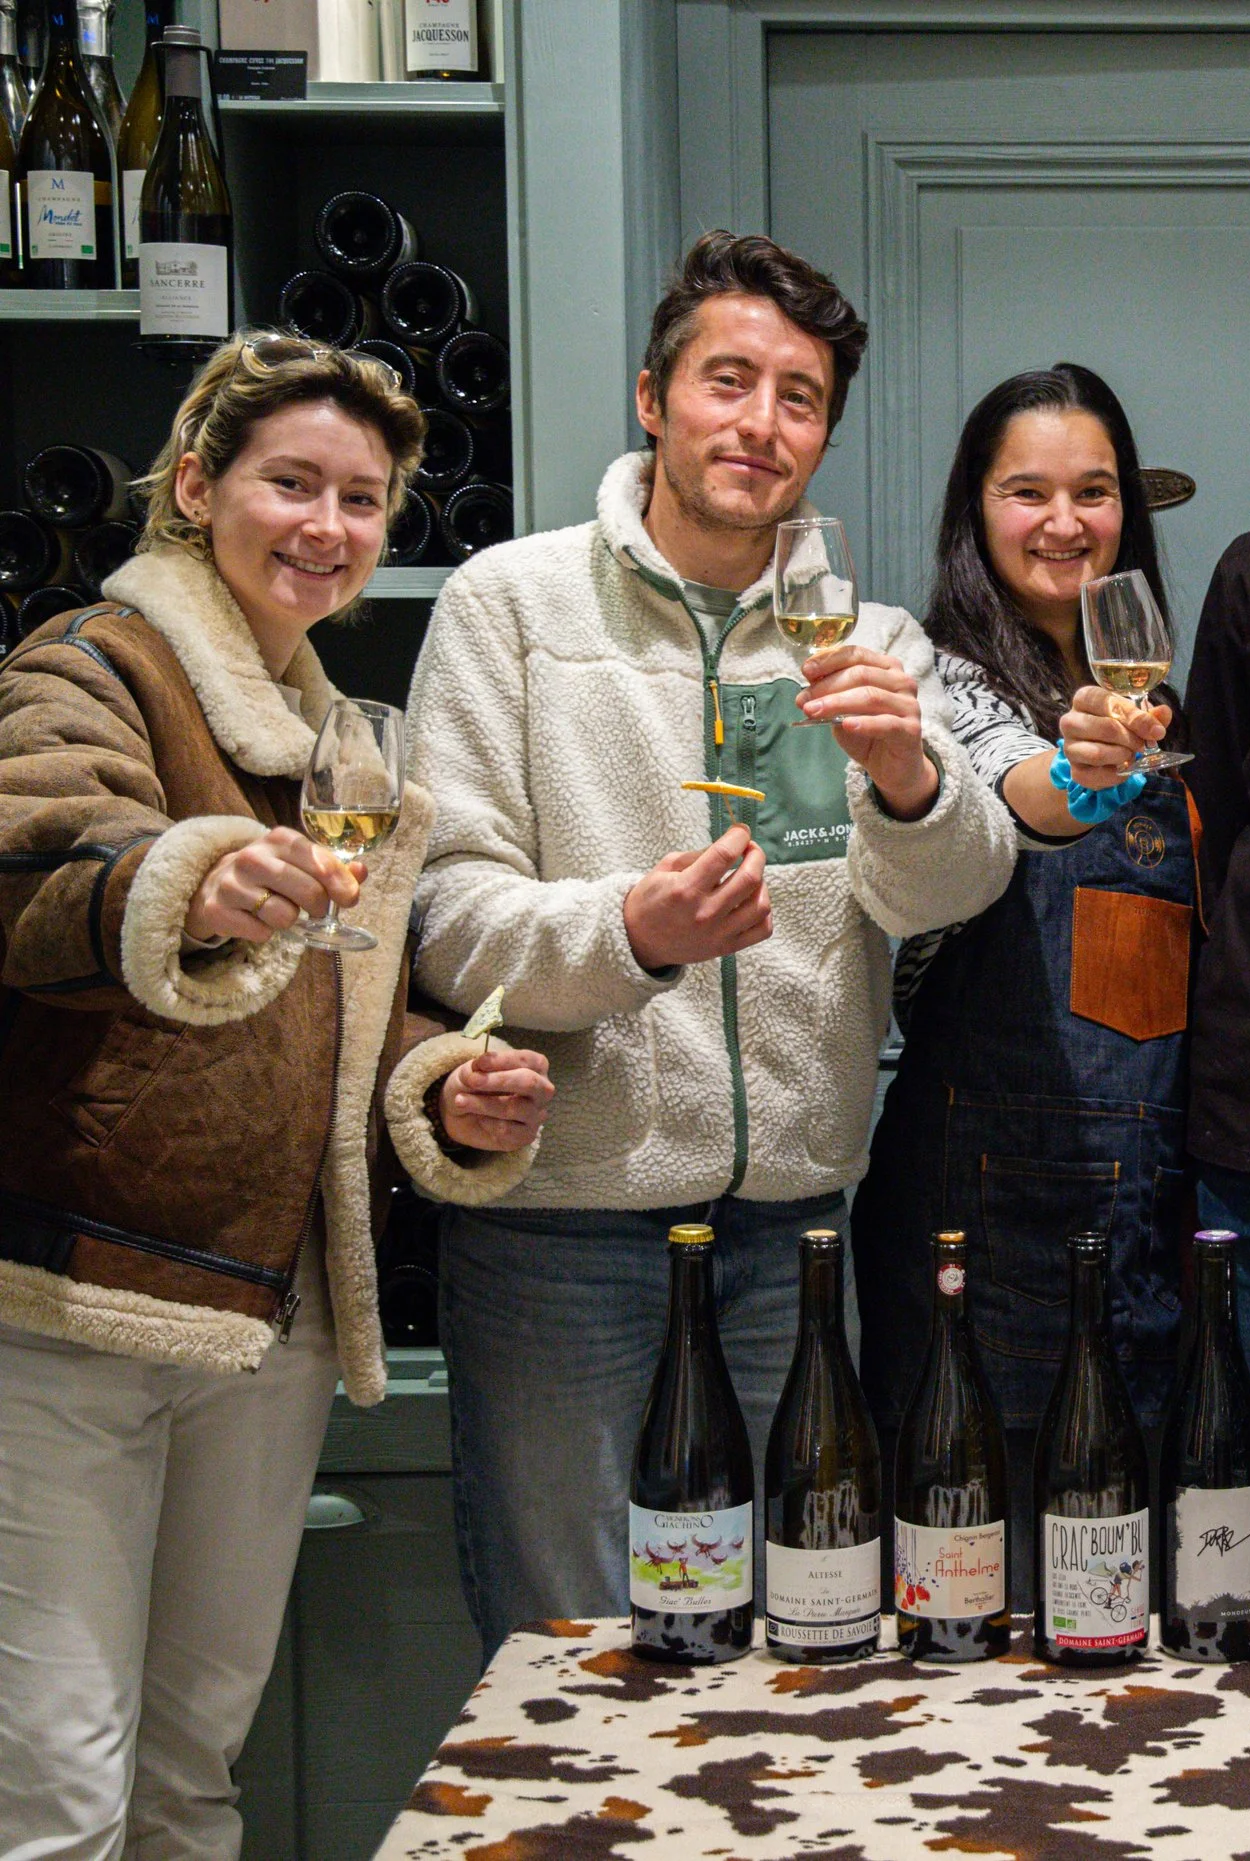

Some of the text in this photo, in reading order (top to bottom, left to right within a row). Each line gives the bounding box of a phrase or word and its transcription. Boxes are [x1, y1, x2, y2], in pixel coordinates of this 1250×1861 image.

[412, 29, 469, 42] JACQUESSON
[51, 178, 65, 190] M
[149, 279, 206, 289] SANCERRE
[938, 1547, 963, 1559] Saint
[1051, 1522, 1088, 1572] CRAC
[935, 1558, 1000, 1577] Anthelme
[807, 1570, 843, 1579] ALTESSE
[769, 1589, 878, 1606] DOMAINE SAINT-GERMAIN
[780, 1621, 873, 1641] ROUSSETTE DE SAVOIE
[1059, 1633, 1143, 1646] DOMAINE SAINT-GERMAIN
